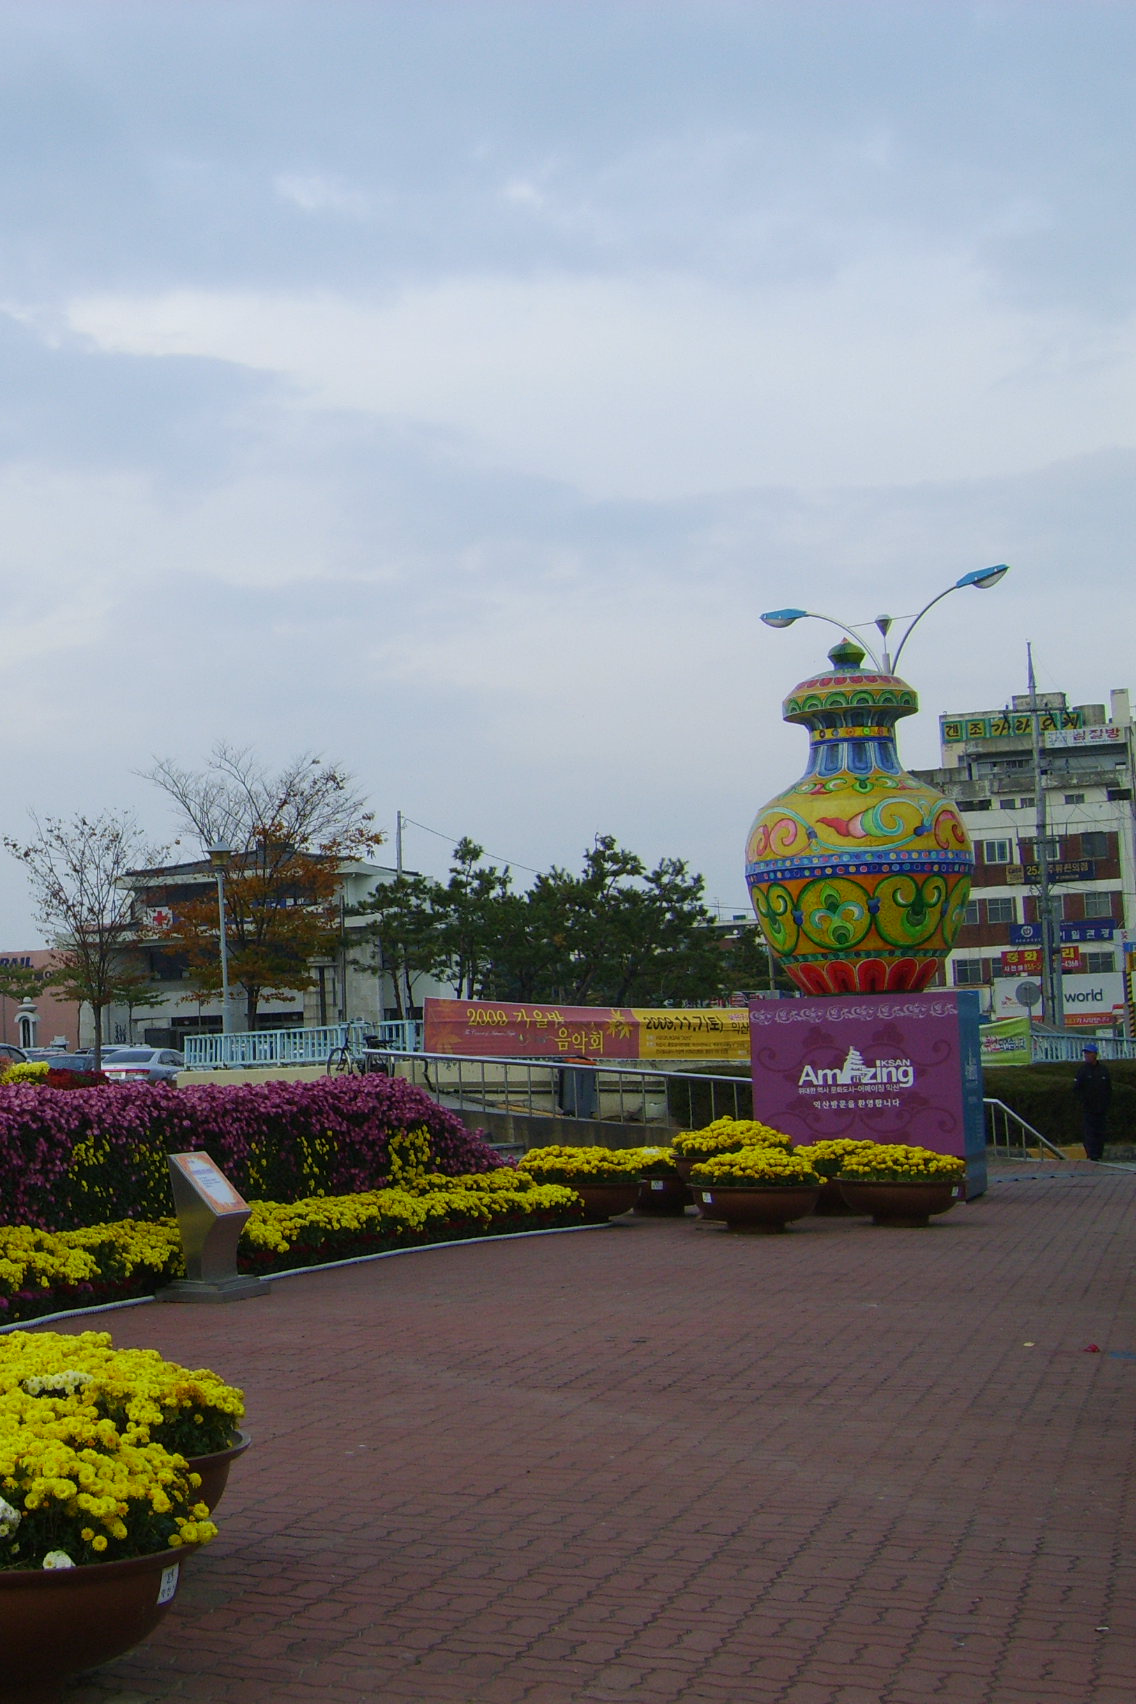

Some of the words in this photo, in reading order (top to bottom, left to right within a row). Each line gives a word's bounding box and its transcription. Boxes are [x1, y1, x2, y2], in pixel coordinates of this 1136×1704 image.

[1064, 988, 1104, 1003] world
[466, 1008, 509, 1026] 2009
[554, 1027, 604, 1055] 음악회
